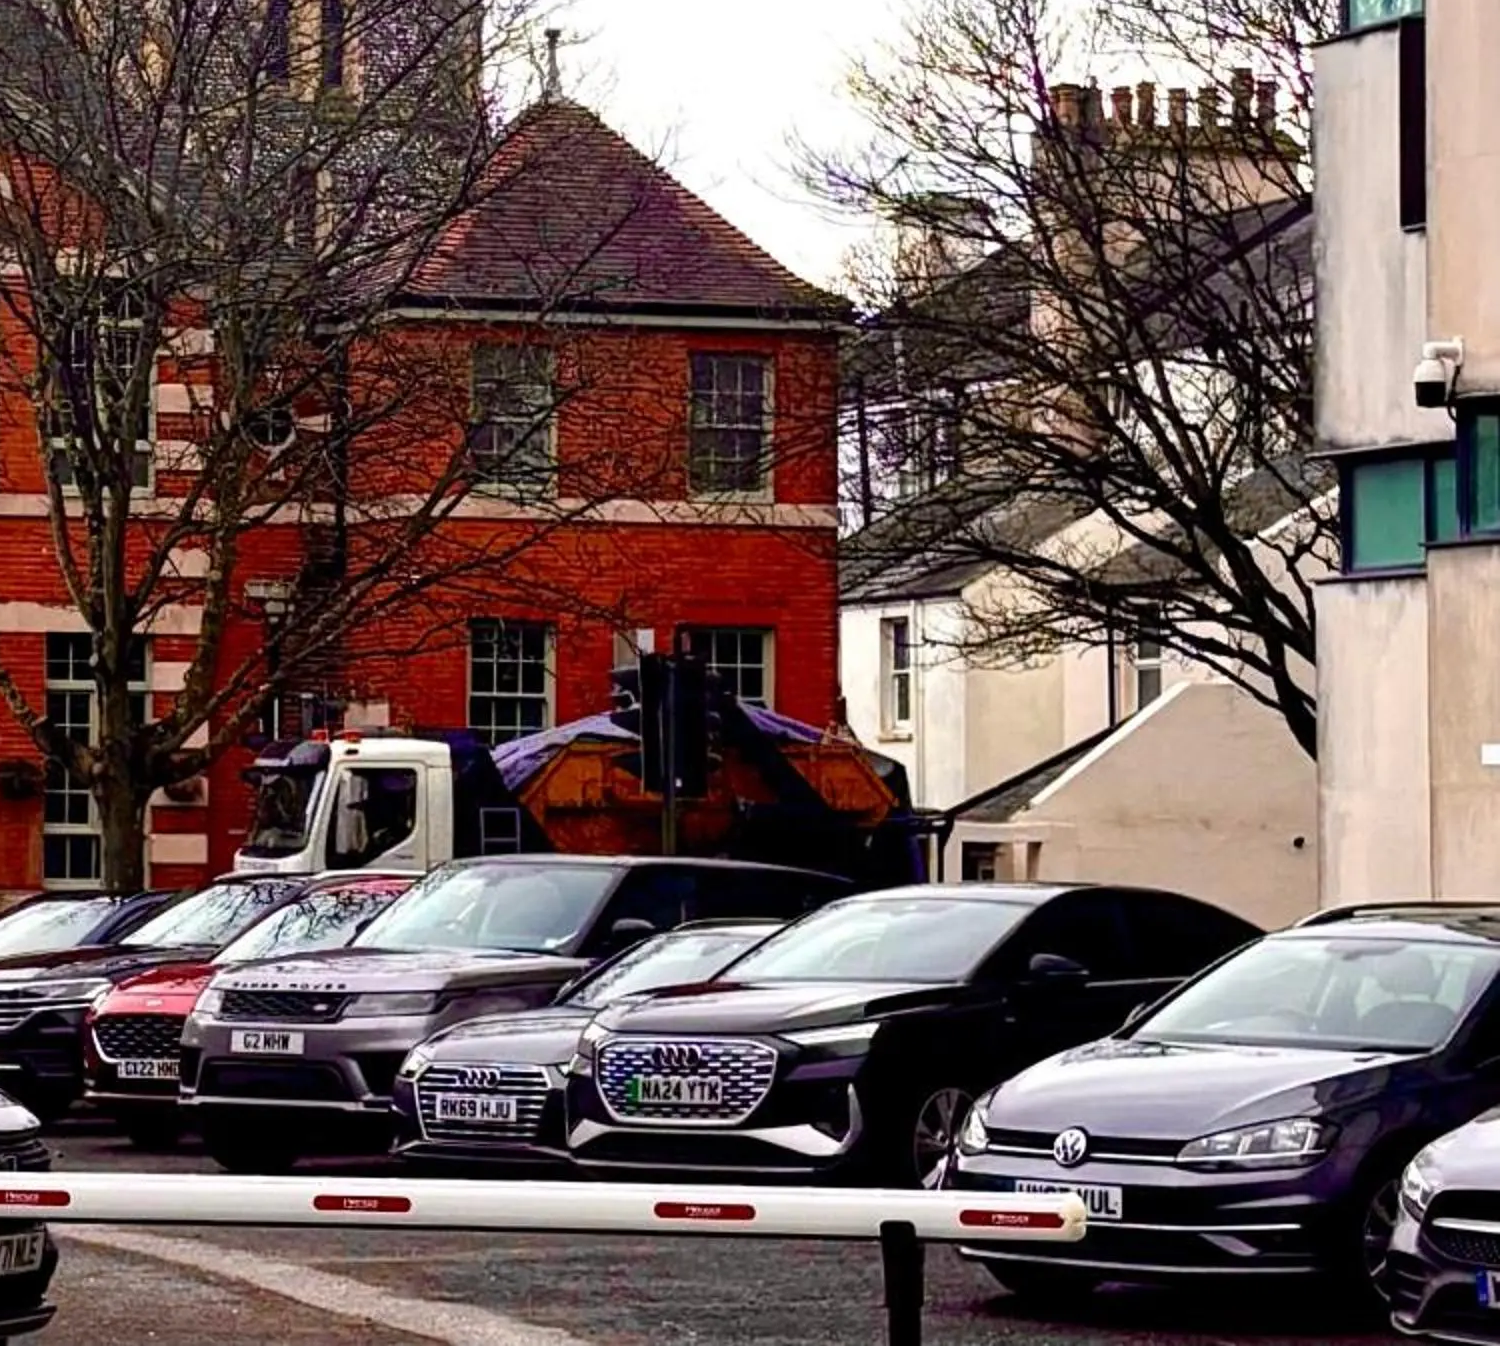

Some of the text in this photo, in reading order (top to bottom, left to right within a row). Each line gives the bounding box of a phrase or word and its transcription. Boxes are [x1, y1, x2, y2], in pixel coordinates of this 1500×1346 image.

[243, 1033, 260, 1050] G2
[642, 1080, 720, 1102] NA24 YTK
[441, 1099, 511, 1119] RK69 HJU
